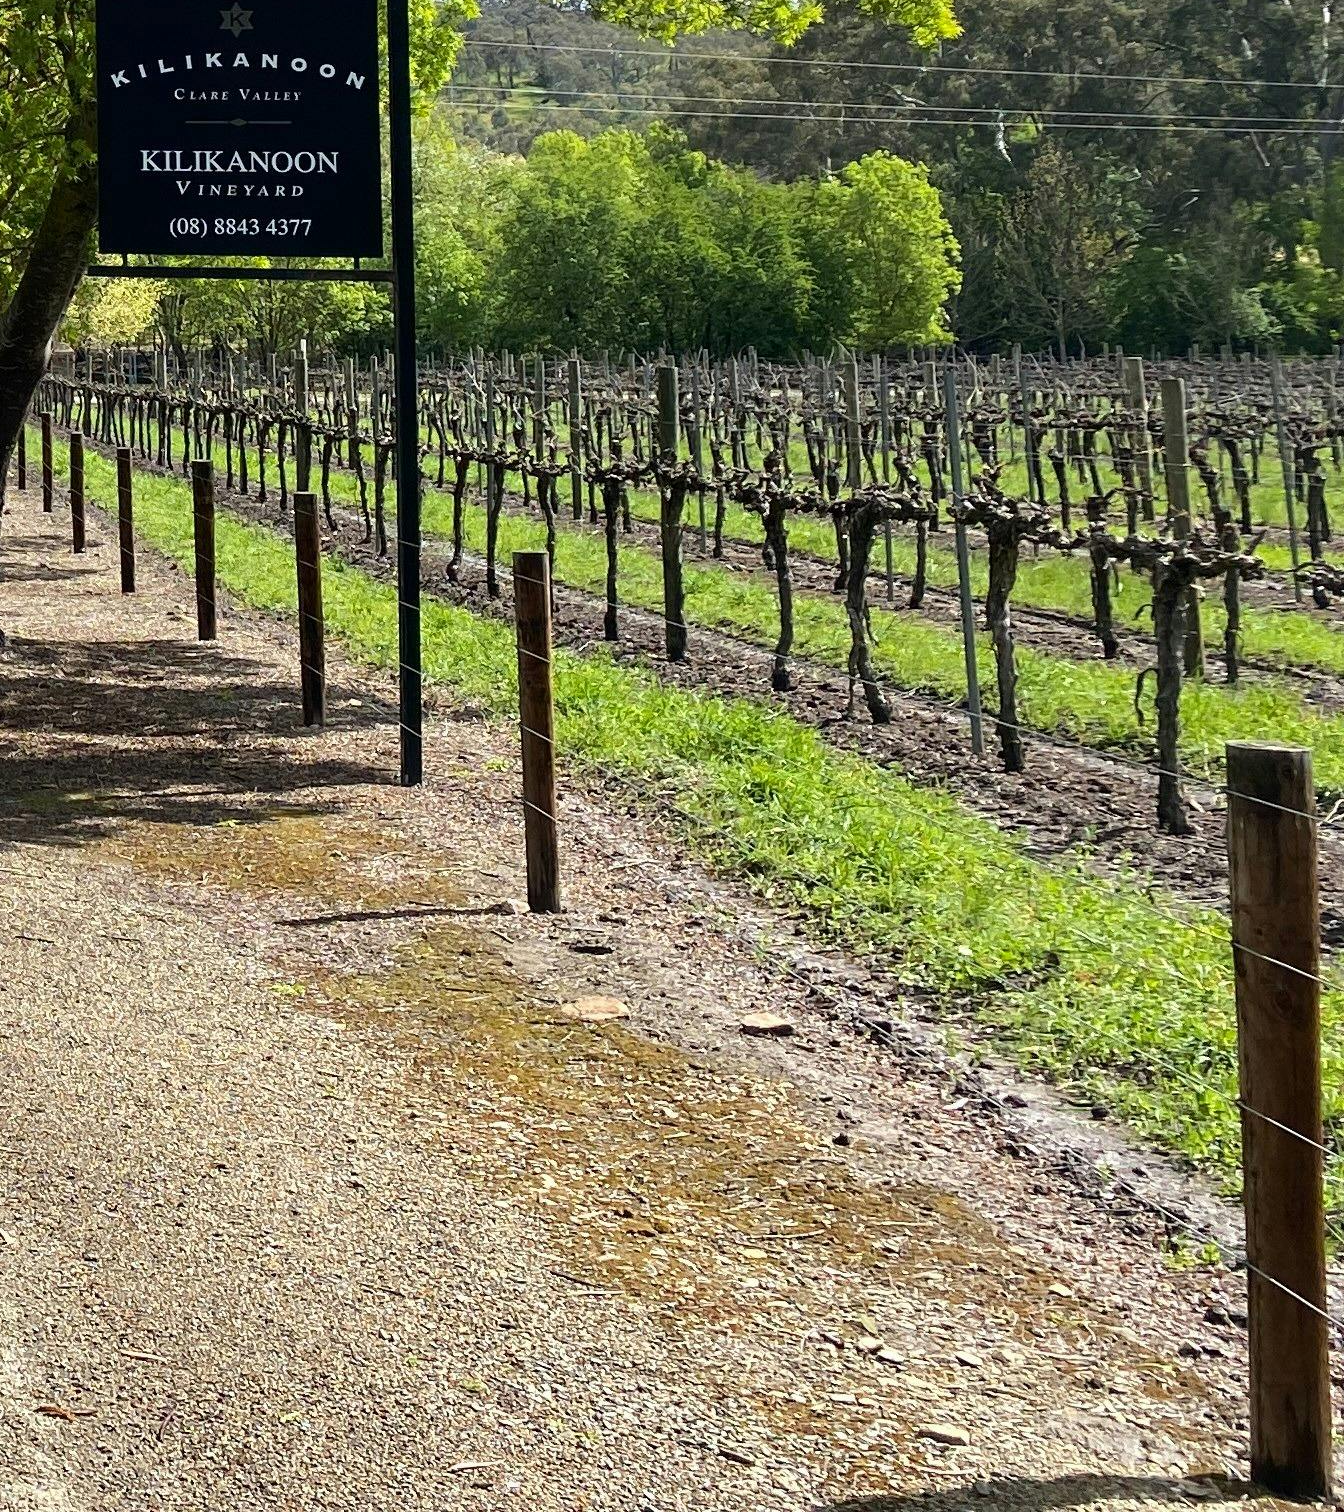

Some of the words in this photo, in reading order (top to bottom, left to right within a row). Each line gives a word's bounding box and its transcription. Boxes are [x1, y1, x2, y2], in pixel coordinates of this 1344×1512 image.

[110, 52, 366, 90] KILIKANOON
[174, 88, 229, 101] CLARE
[238, 88, 302, 101] VALLEY
[139, 149, 339, 174] KILIKANOON
[175, 180, 304, 197] VINEYARD
[169, 217, 208, 239] (08)
[214, 217, 260, 236] 8843
[265, 218, 312, 237] 4377
